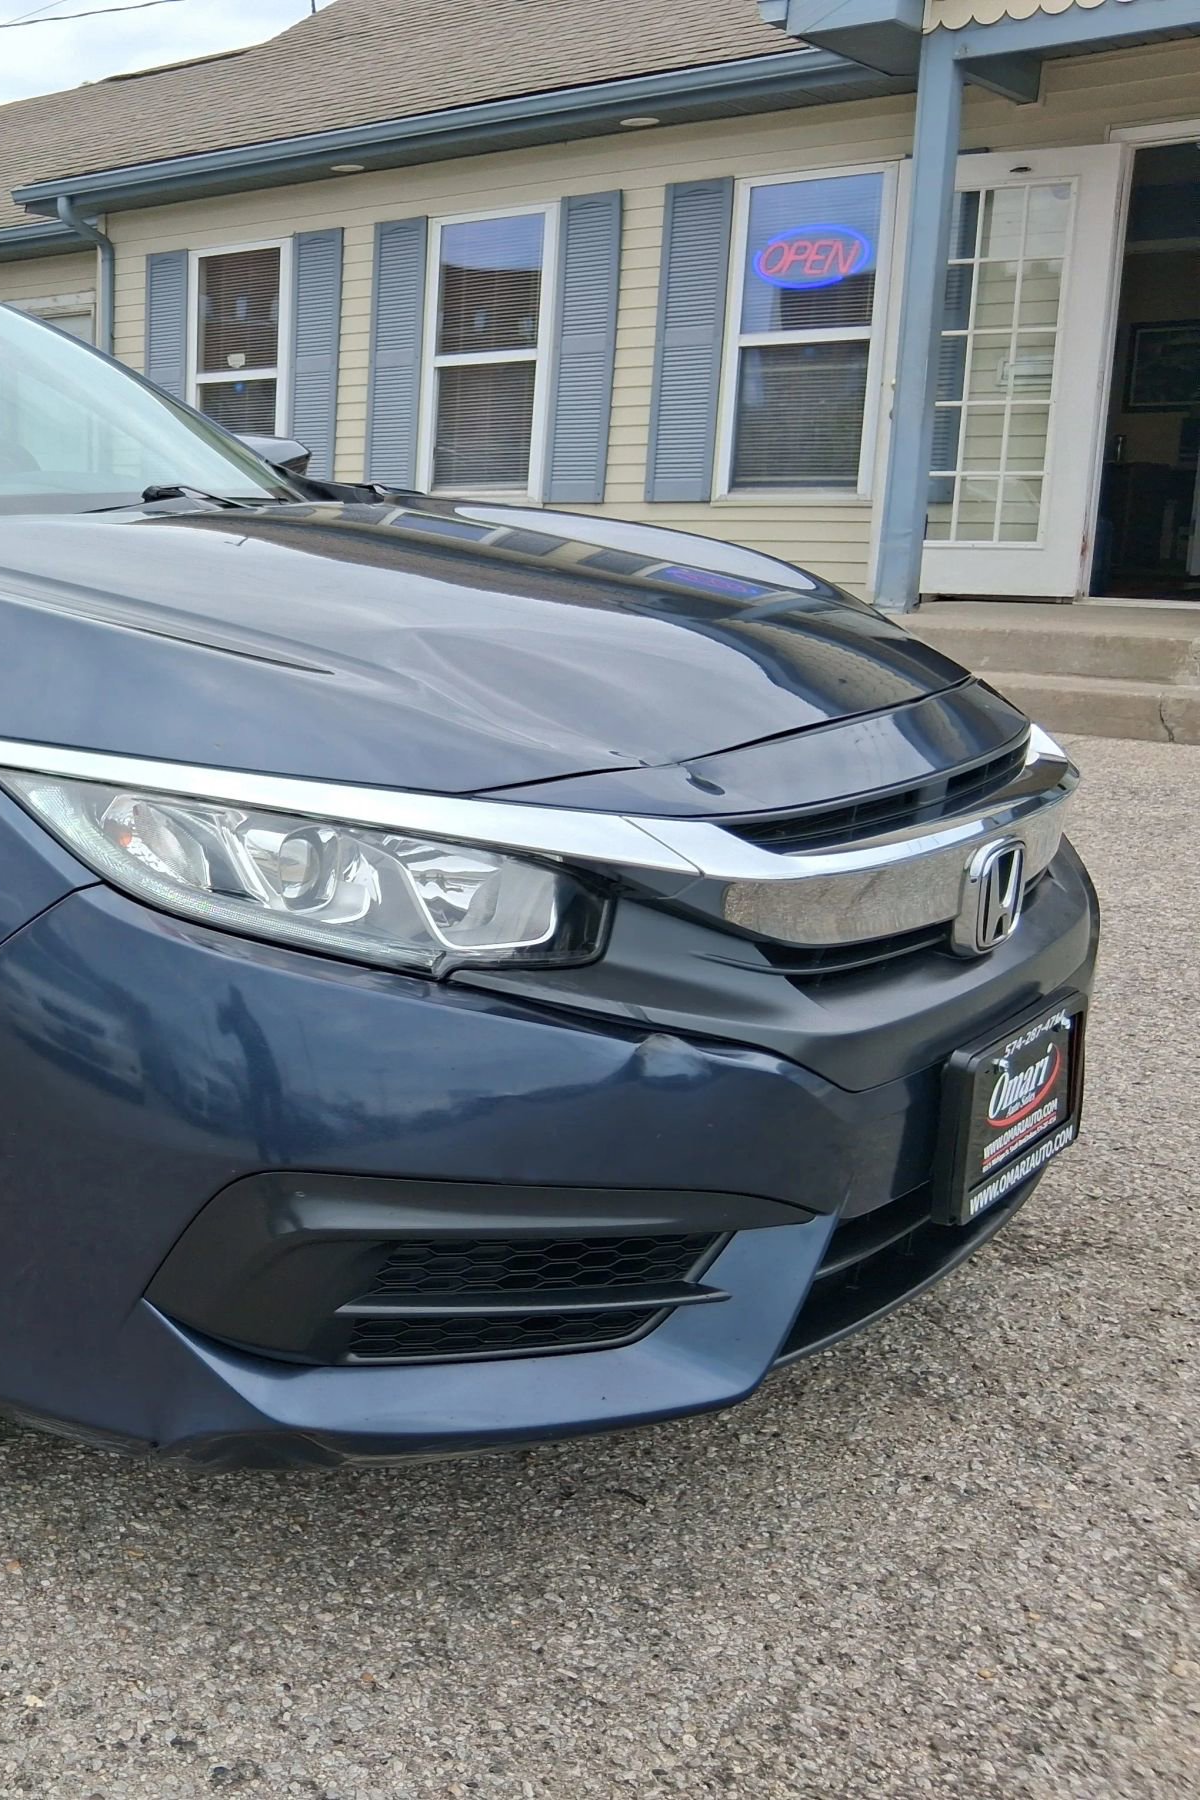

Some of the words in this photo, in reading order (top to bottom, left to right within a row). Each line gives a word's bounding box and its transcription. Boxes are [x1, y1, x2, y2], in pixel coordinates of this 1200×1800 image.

[759, 238, 861, 276] OPEN
[988, 1042, 1054, 1119] Omari
[983, 1098, 1058, 1160] WWW.OMARIAUTO.COM
[969, 1124, 1074, 1216] WWW.OMARIAUTO.COM
